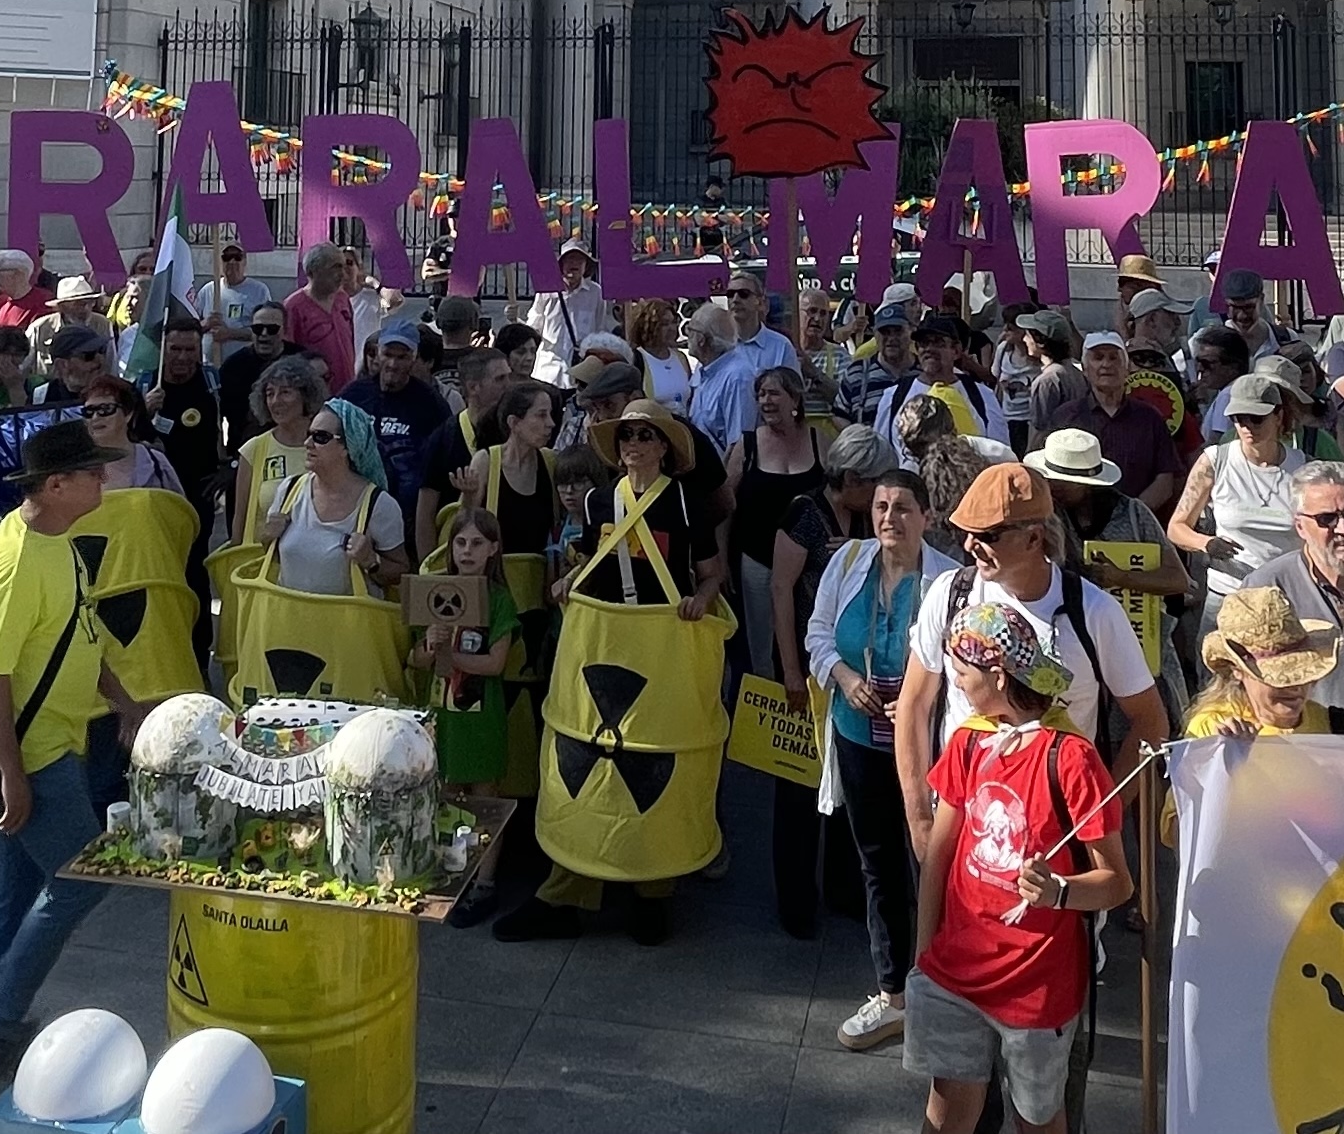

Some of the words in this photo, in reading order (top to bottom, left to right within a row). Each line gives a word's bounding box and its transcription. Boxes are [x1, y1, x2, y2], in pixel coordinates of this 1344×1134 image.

[758, 712, 768, 726] Y
[770, 715, 813, 741] TODAS
[772, 734, 818, 761] DEMÁS
[202, 903, 238, 928] SANTA
[240, 914, 289, 933] OLALLA
